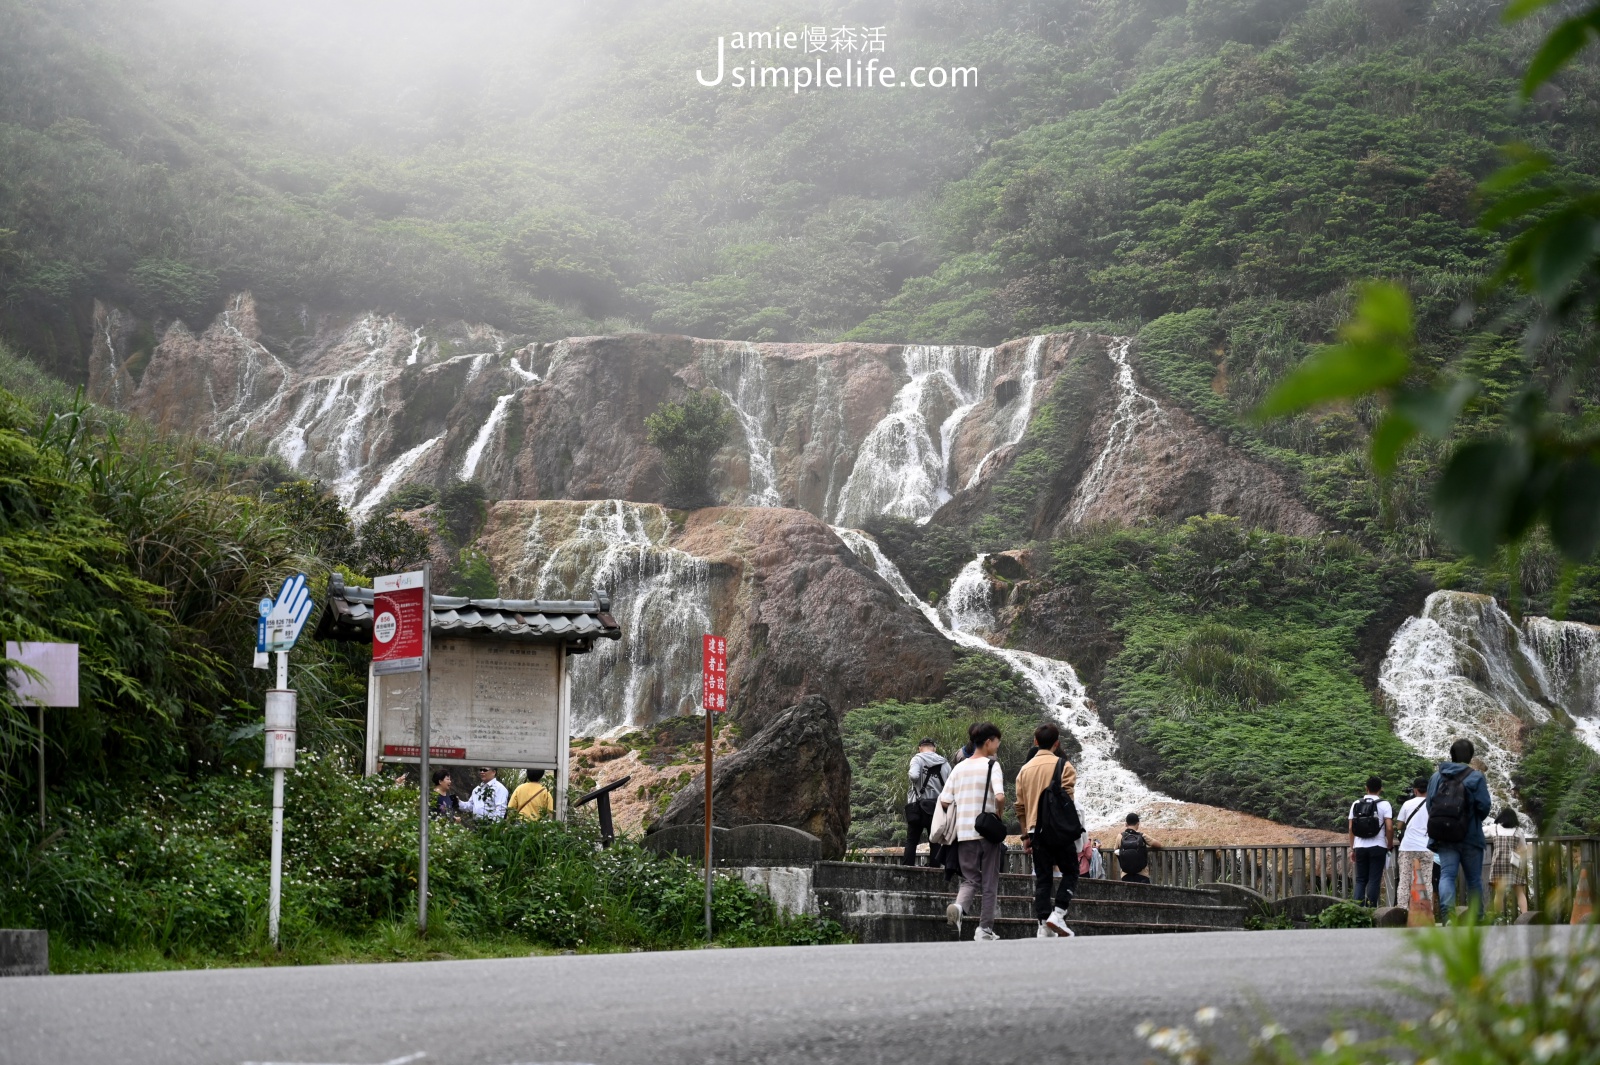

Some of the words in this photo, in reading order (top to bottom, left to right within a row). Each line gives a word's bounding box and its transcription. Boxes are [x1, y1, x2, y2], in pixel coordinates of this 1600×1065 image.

[708, 637, 716, 708] 違者告發
[716, 639, 725, 709] 禁止設攤
